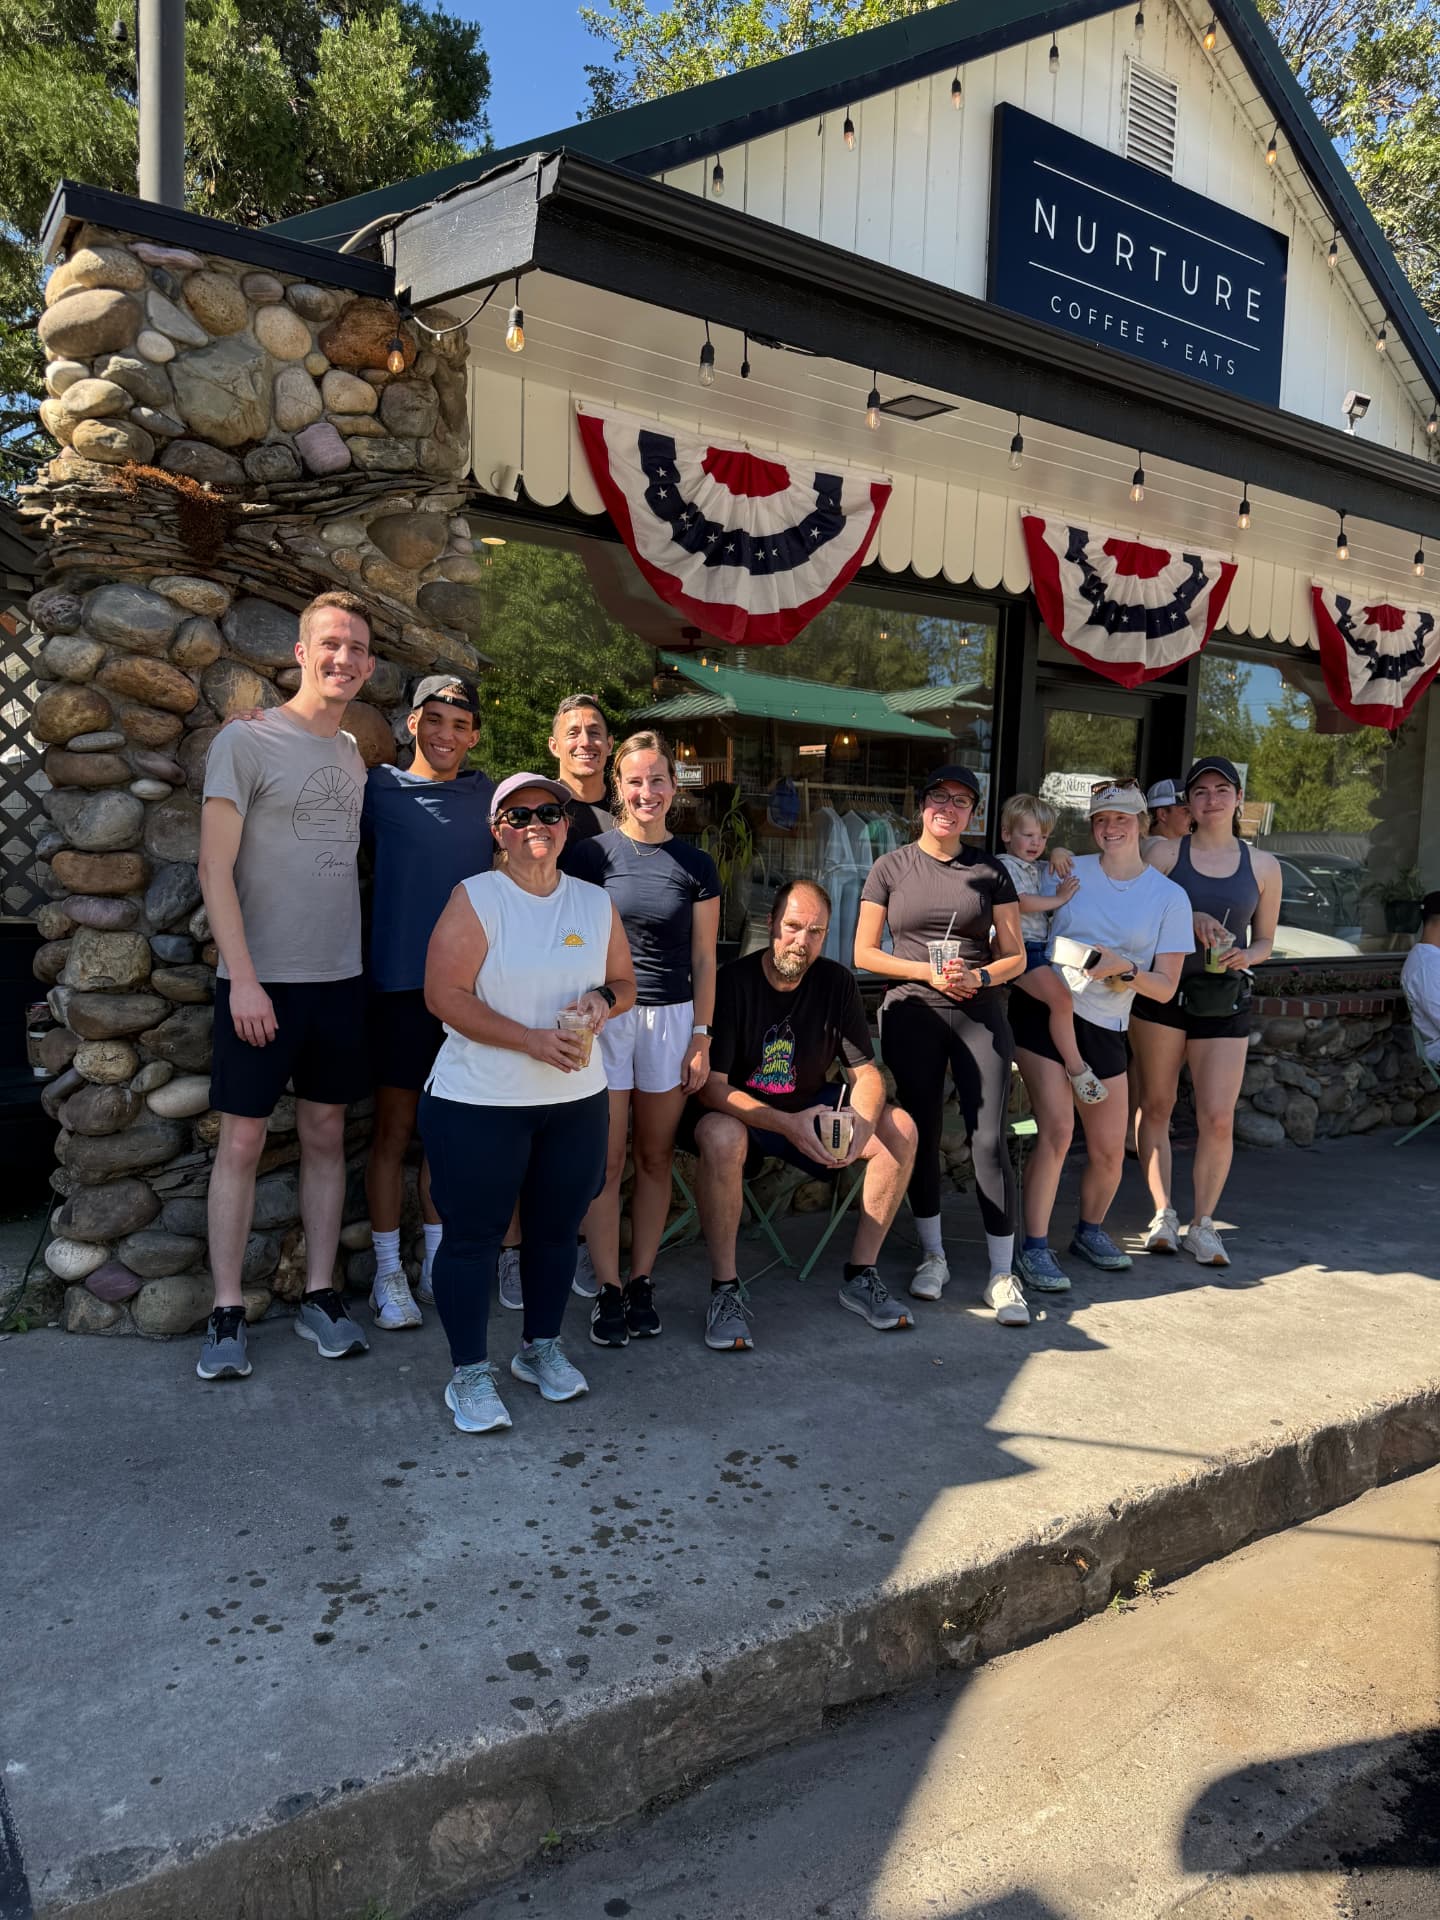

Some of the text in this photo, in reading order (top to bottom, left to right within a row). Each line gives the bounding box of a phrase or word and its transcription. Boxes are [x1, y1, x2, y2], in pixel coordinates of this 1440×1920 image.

[1034, 198, 1262, 322] NURTURE
[1050, 295, 1145, 344] COFFEE
[1185, 343, 1235, 376] EATS
[1066, 779, 1091, 793] NURT
